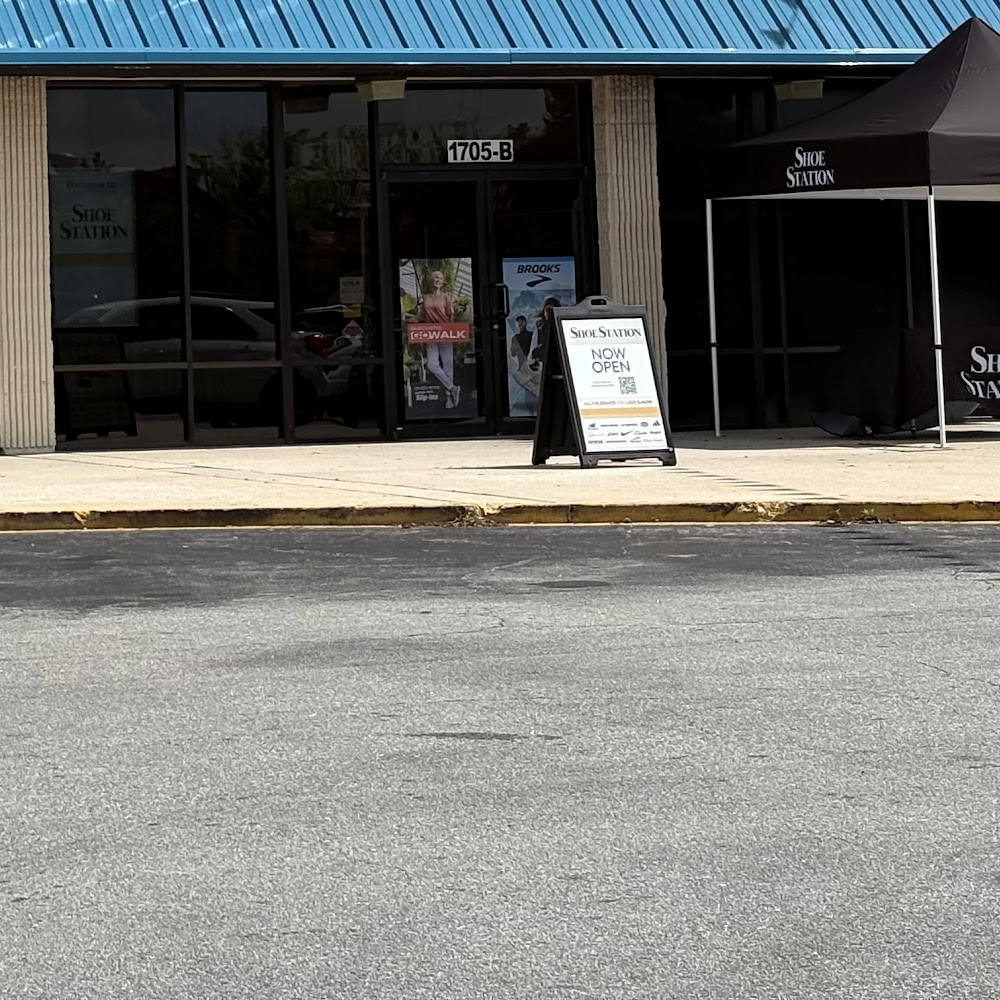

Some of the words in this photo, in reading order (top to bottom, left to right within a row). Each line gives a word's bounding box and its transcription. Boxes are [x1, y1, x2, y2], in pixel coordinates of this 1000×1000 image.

[449, 141, 512, 161] 1705-B
[794, 146, 826, 168] SHOE
[786, 166, 835, 188] STATION
[72, 203, 116, 223] SHOE
[60, 220, 128, 240] STATION
[517, 264, 561, 274] BROOKS
[570, 327, 598, 339] SHOE
[598, 326, 642, 338] STATION
[591, 347, 625, 360] NOW
[592, 361, 630, 373] OPEN
